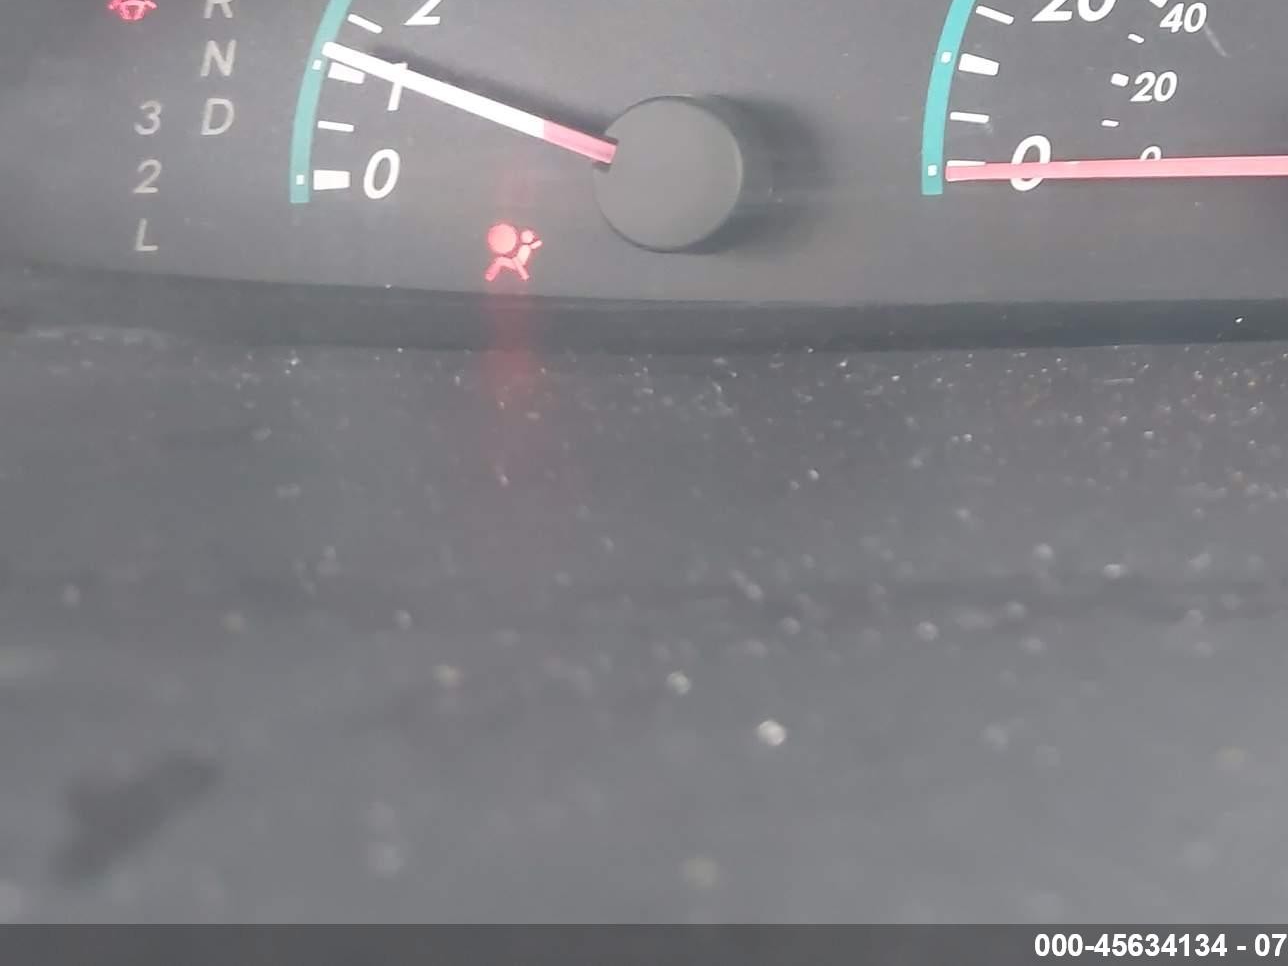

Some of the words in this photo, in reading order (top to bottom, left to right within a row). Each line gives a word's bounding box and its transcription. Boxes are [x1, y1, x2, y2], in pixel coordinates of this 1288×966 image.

[1160, 2, 1207, 33] 40
[201, 40, 236, 77] N
[1130, 71, 1178, 102] 20
[134, 100, 161, 135] 3
[201, 98, 234, 136] D
[133, 159, 162, 193] 2
[363, 149, 400, 200] 0
[1010, 135, 1051, 191] 0
[134, 218, 158, 251] L
